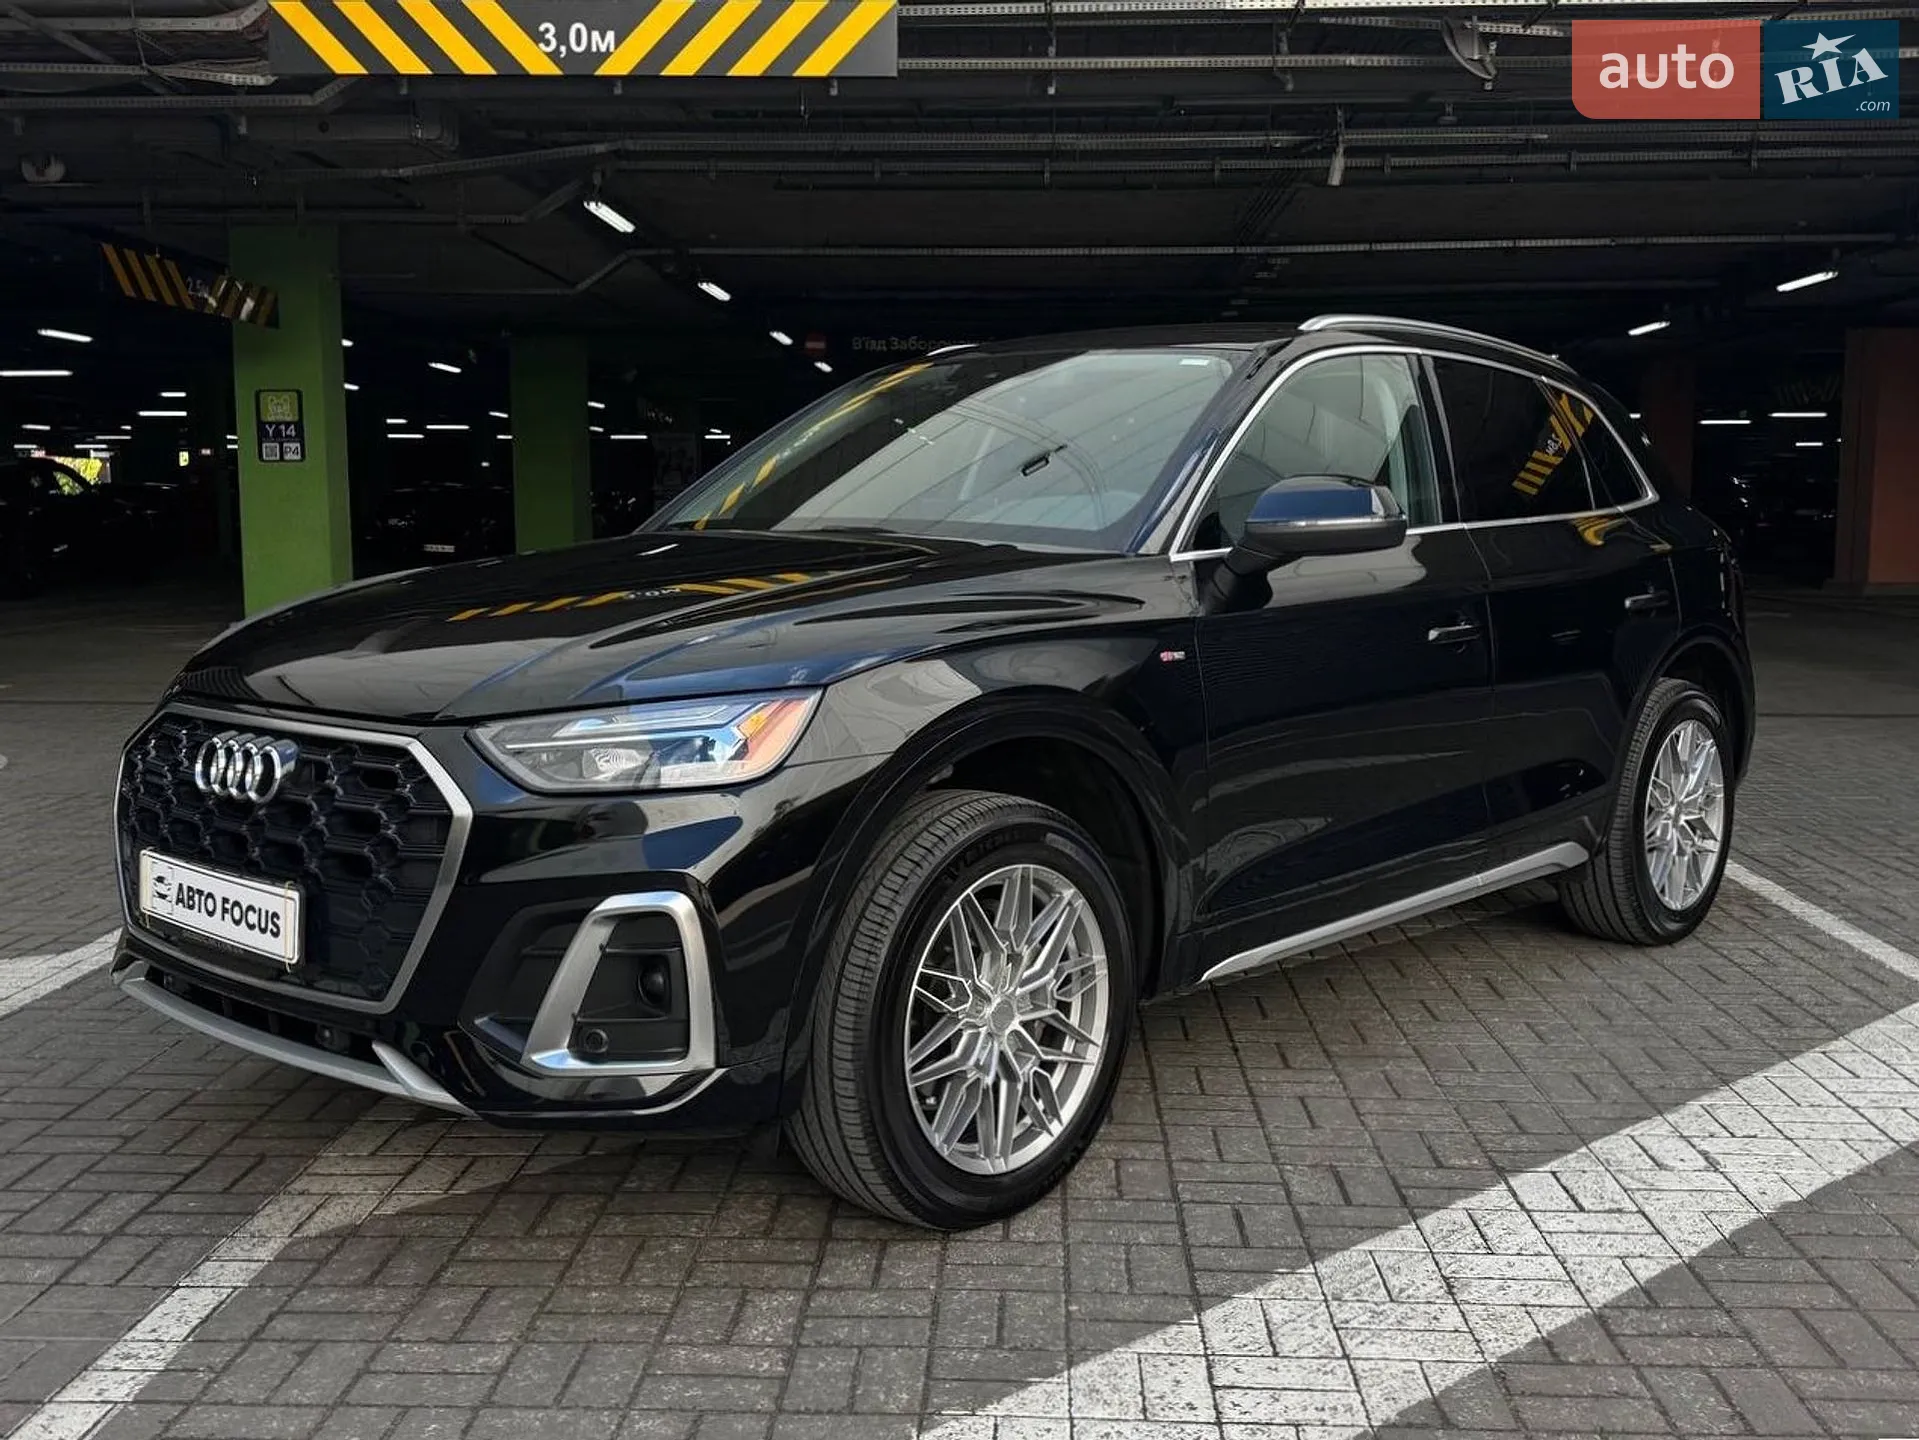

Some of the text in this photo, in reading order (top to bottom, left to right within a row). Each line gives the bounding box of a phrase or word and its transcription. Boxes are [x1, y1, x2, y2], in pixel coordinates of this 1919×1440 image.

[538, 21, 616, 58] 3,0м
[279, 424, 296, 437] 14
[220, 896, 281, 939] FOCUS
